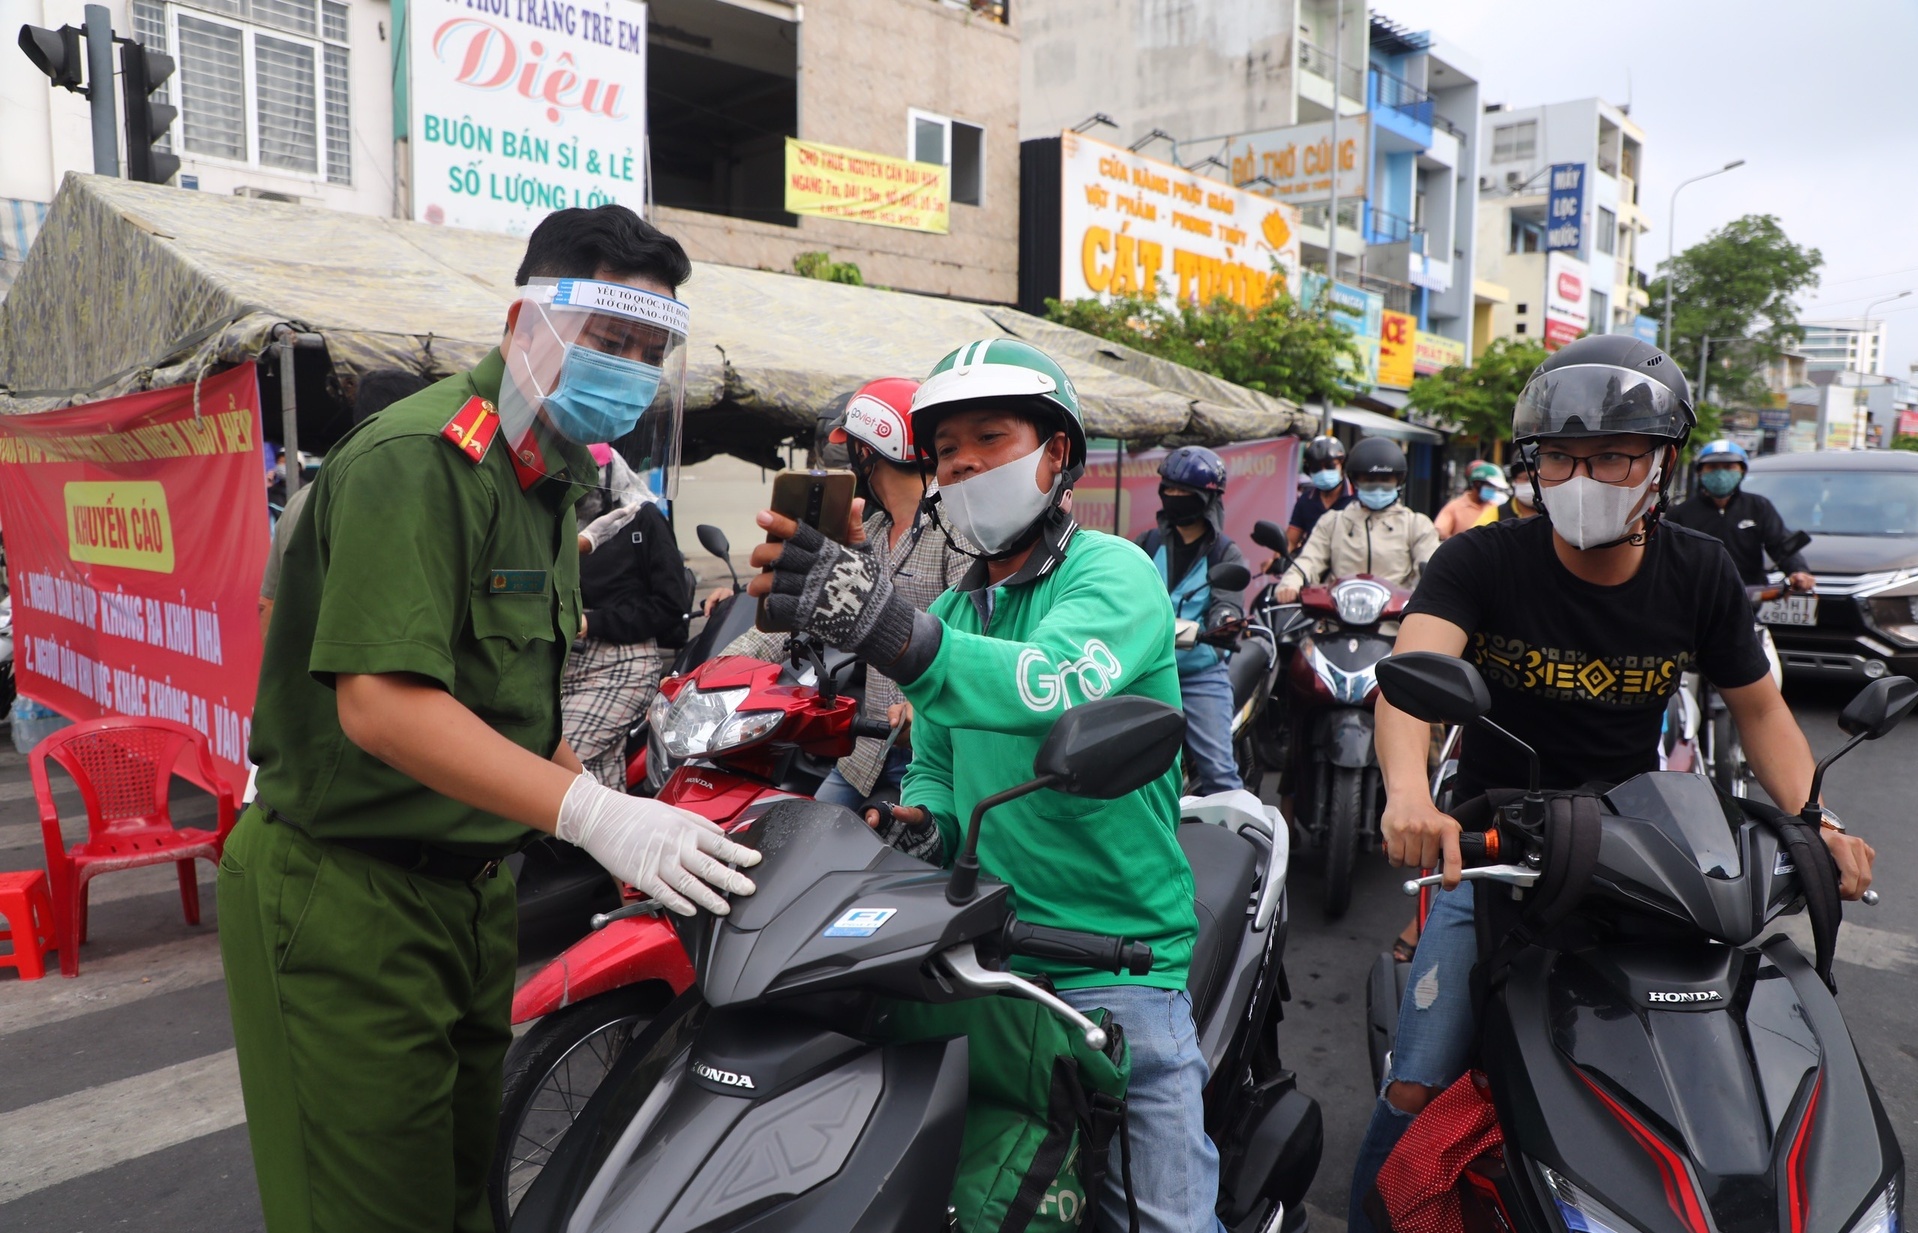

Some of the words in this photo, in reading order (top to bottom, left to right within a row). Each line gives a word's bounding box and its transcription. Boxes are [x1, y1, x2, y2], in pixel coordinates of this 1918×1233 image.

[618, 21, 641, 54] EM
[433, 17, 628, 124] Diệu
[424, 115, 492, 153] BUÔN
[502, 128, 549, 164] BÁN
[558, 136, 579, 170] SỈ
[586, 149, 601, 175] &
[610, 147, 634, 181] LẺ
[449, 159, 483, 196] SỐ
[491, 172, 567, 211] LƯỢNG
[1081, 220, 1163, 300] CÁT
[73, 493, 129, 550] KHUYẾN
[131, 498, 163, 553] CÁO
[99, 584, 145, 642] KHÔNG
[146, 598, 164, 647] RA
[164, 588, 194, 657] KHỎI
[195, 601, 223, 666] NHÀ
[114, 664, 147, 716] KHÁC
[149, 675, 190, 726] KHÔNG
[214, 695, 240, 766] VÀO
[684, 777, 714, 790] HONDA
[848, 911, 888, 921] FI
[1648, 990, 1723, 1003] HONDA
